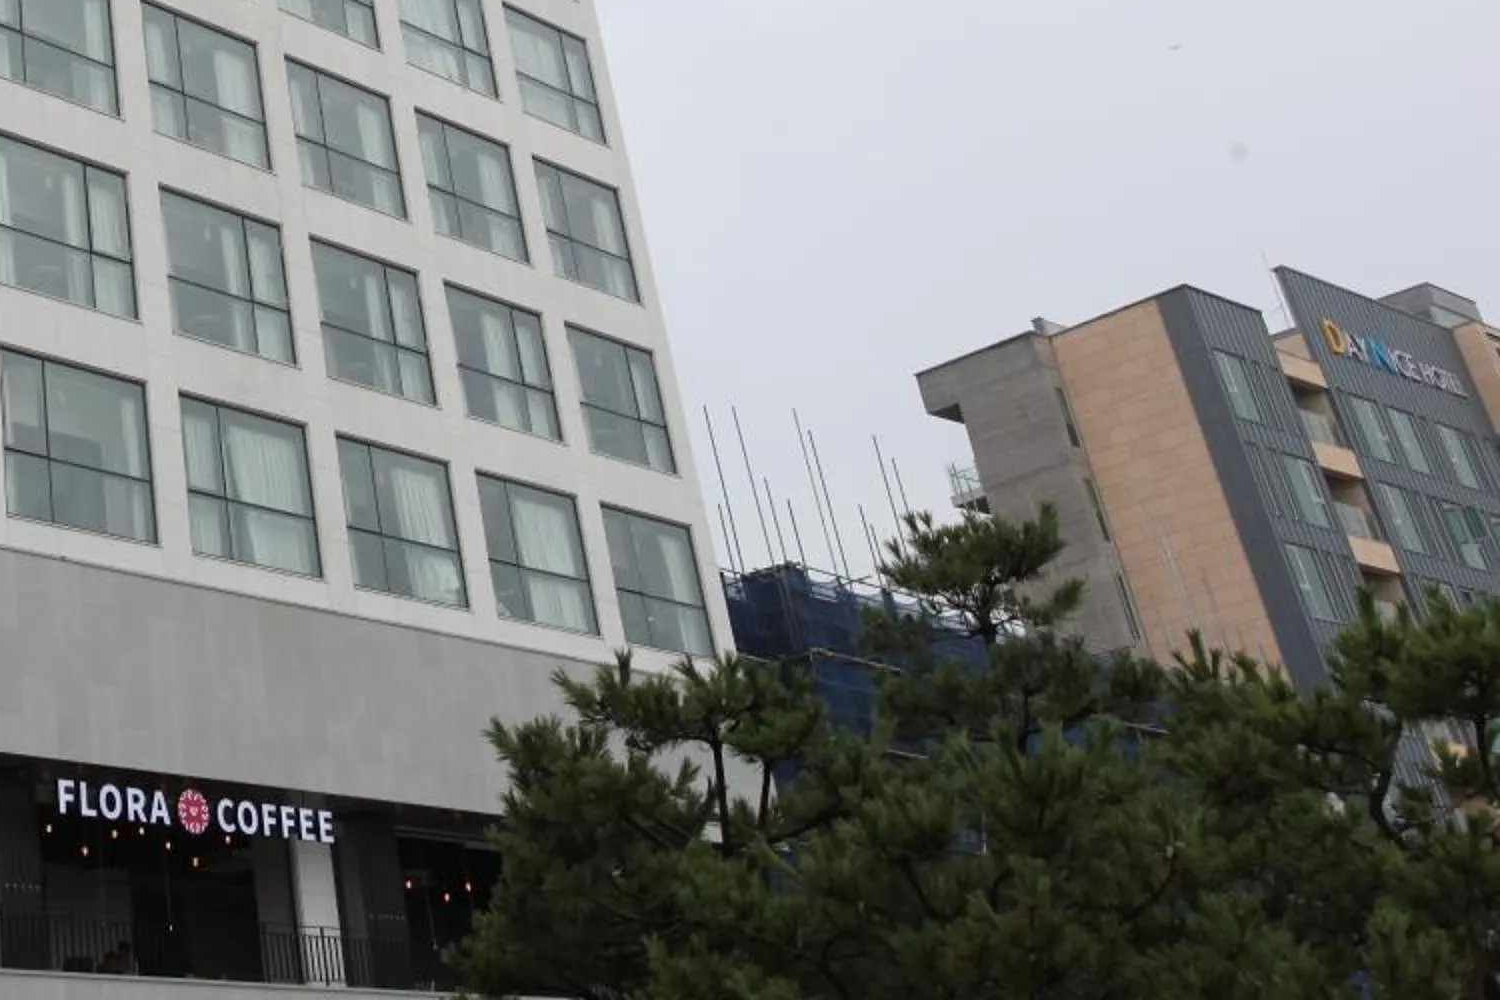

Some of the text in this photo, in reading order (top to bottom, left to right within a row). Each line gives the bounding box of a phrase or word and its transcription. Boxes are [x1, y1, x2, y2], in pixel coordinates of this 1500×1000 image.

[1320, 317, 1369, 363] DAY
[56, 777, 336, 845] FLORA COFFEE
